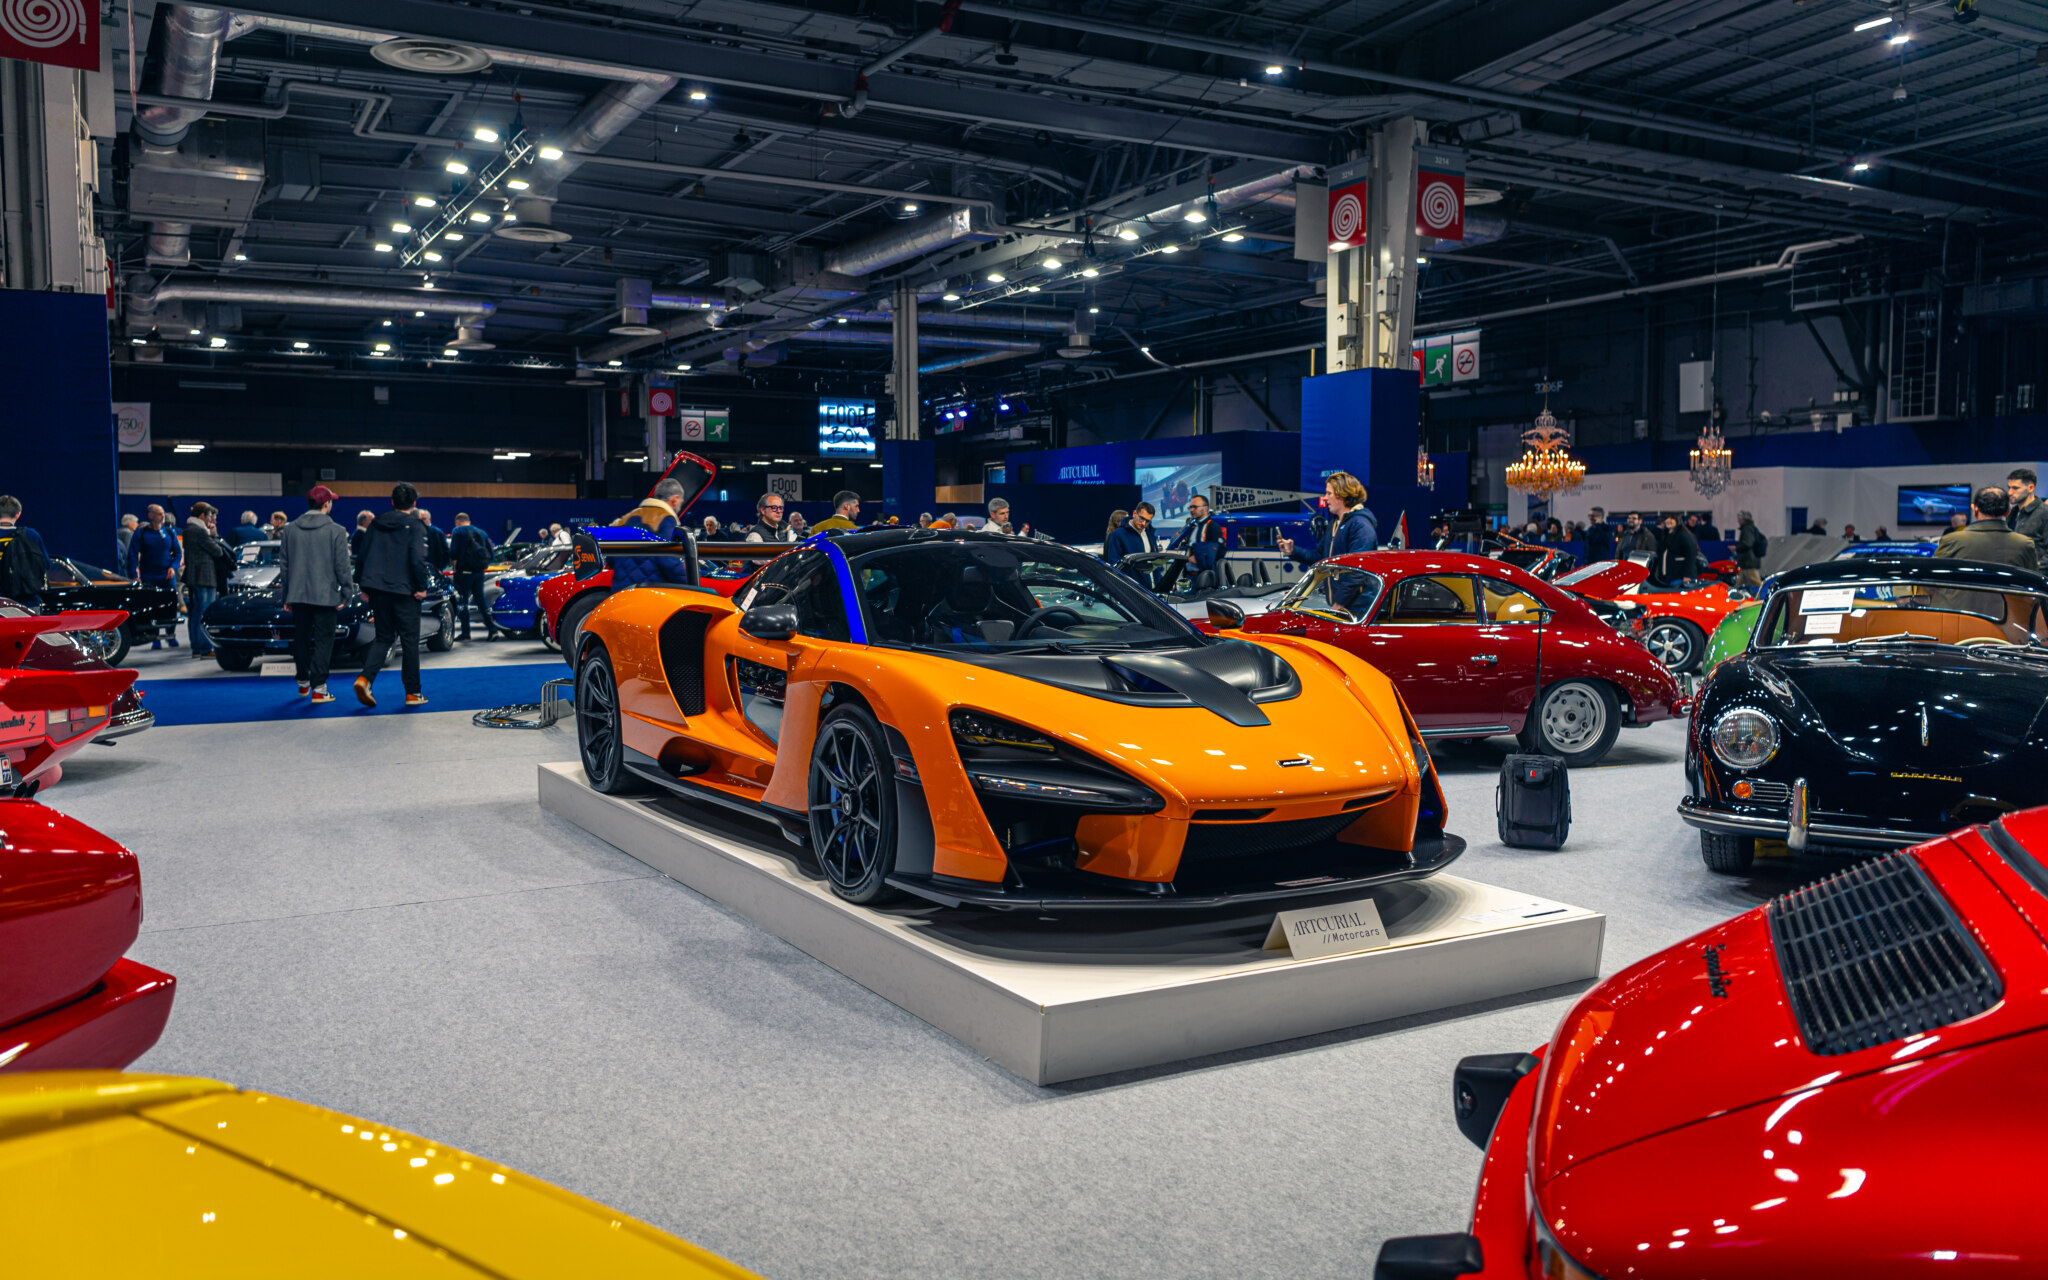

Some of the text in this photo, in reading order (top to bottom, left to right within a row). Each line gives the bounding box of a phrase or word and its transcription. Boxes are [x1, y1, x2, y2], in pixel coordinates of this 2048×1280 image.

[1434, 156, 1450, 166] 3214
[826, 426, 868, 446] BOX
[1058, 464, 1100, 480] ARTCURIAL
[771, 477, 798, 493] FOOD
[1890, 772, 1963, 783] PORSCHE
[1293, 912, 1367, 937] ARTCURIAL
[1323, 928, 1380, 944] //Motorcars
[1701, 943, 1732, 999] Speedster
